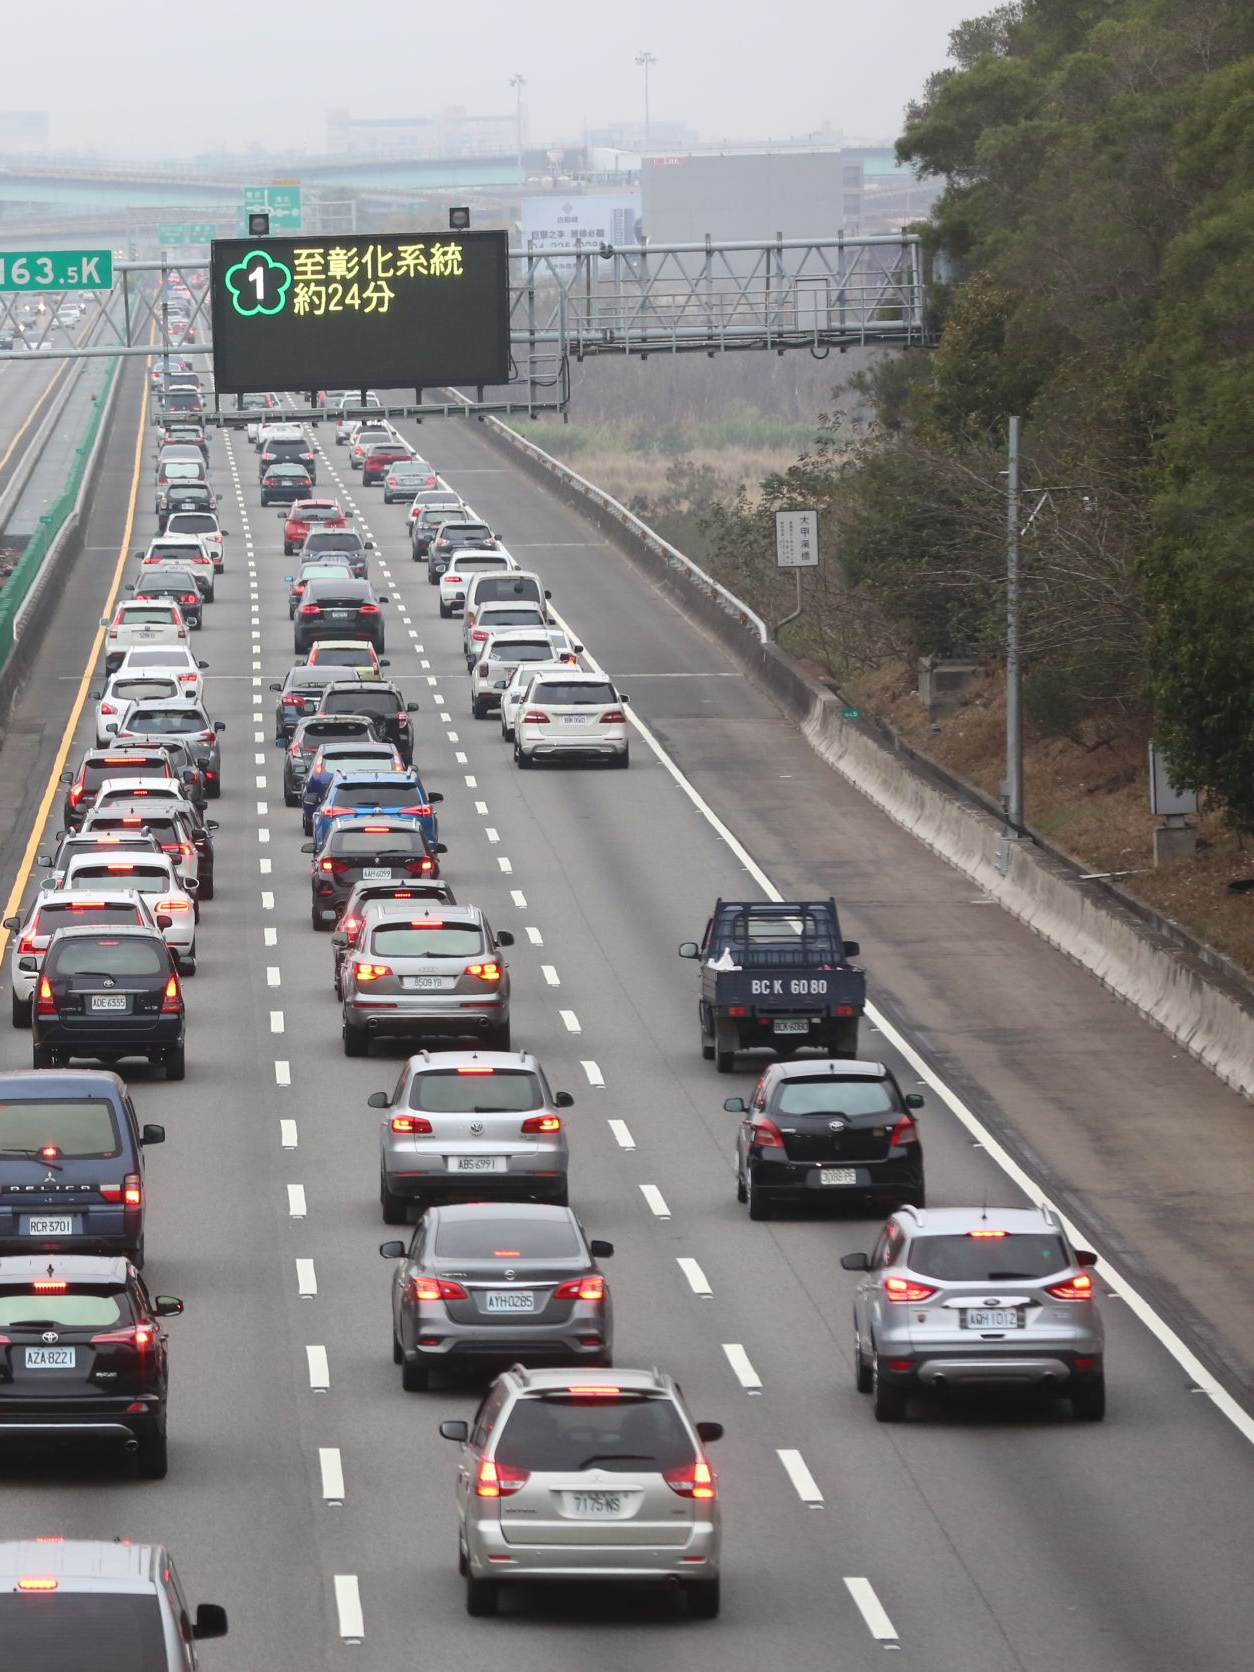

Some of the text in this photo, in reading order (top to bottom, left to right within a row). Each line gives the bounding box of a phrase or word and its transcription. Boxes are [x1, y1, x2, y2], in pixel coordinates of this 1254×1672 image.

[293, 242, 463, 280] 至彰化系統
[248, 266, 264, 300] 1
[293, 280, 395, 316] 約24分
[799, 515, 811, 561] 大甲溪橋
